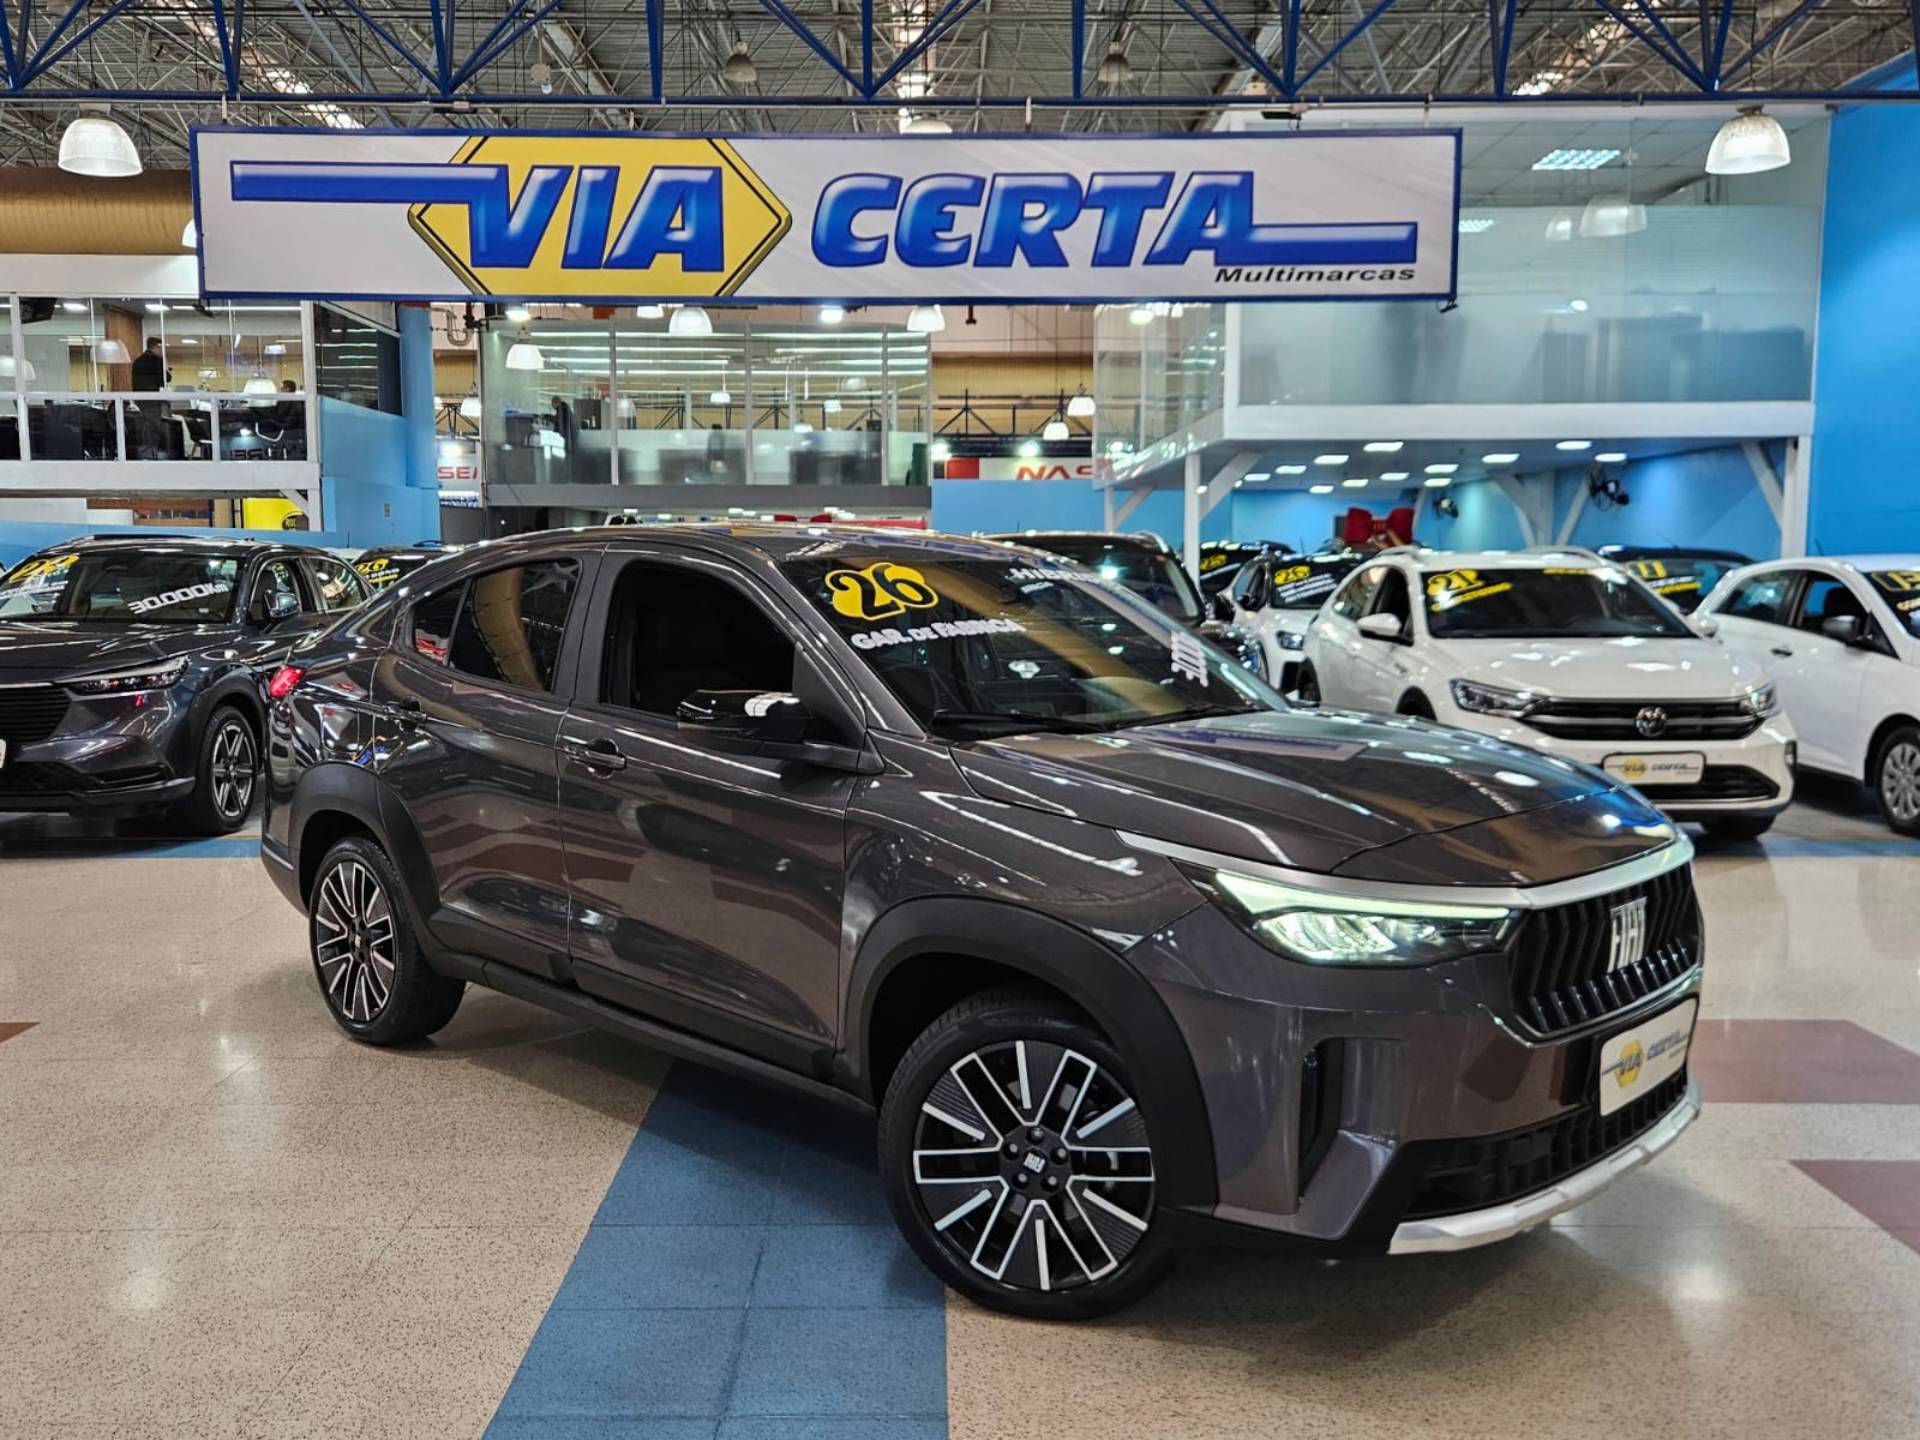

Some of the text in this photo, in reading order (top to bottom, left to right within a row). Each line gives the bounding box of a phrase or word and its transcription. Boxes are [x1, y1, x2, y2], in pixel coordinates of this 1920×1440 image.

[469, 164, 1253, 272] VIA CERTA
[1214, 267, 1416, 283] Multimarcas
[826, 562, 939, 620] 26
